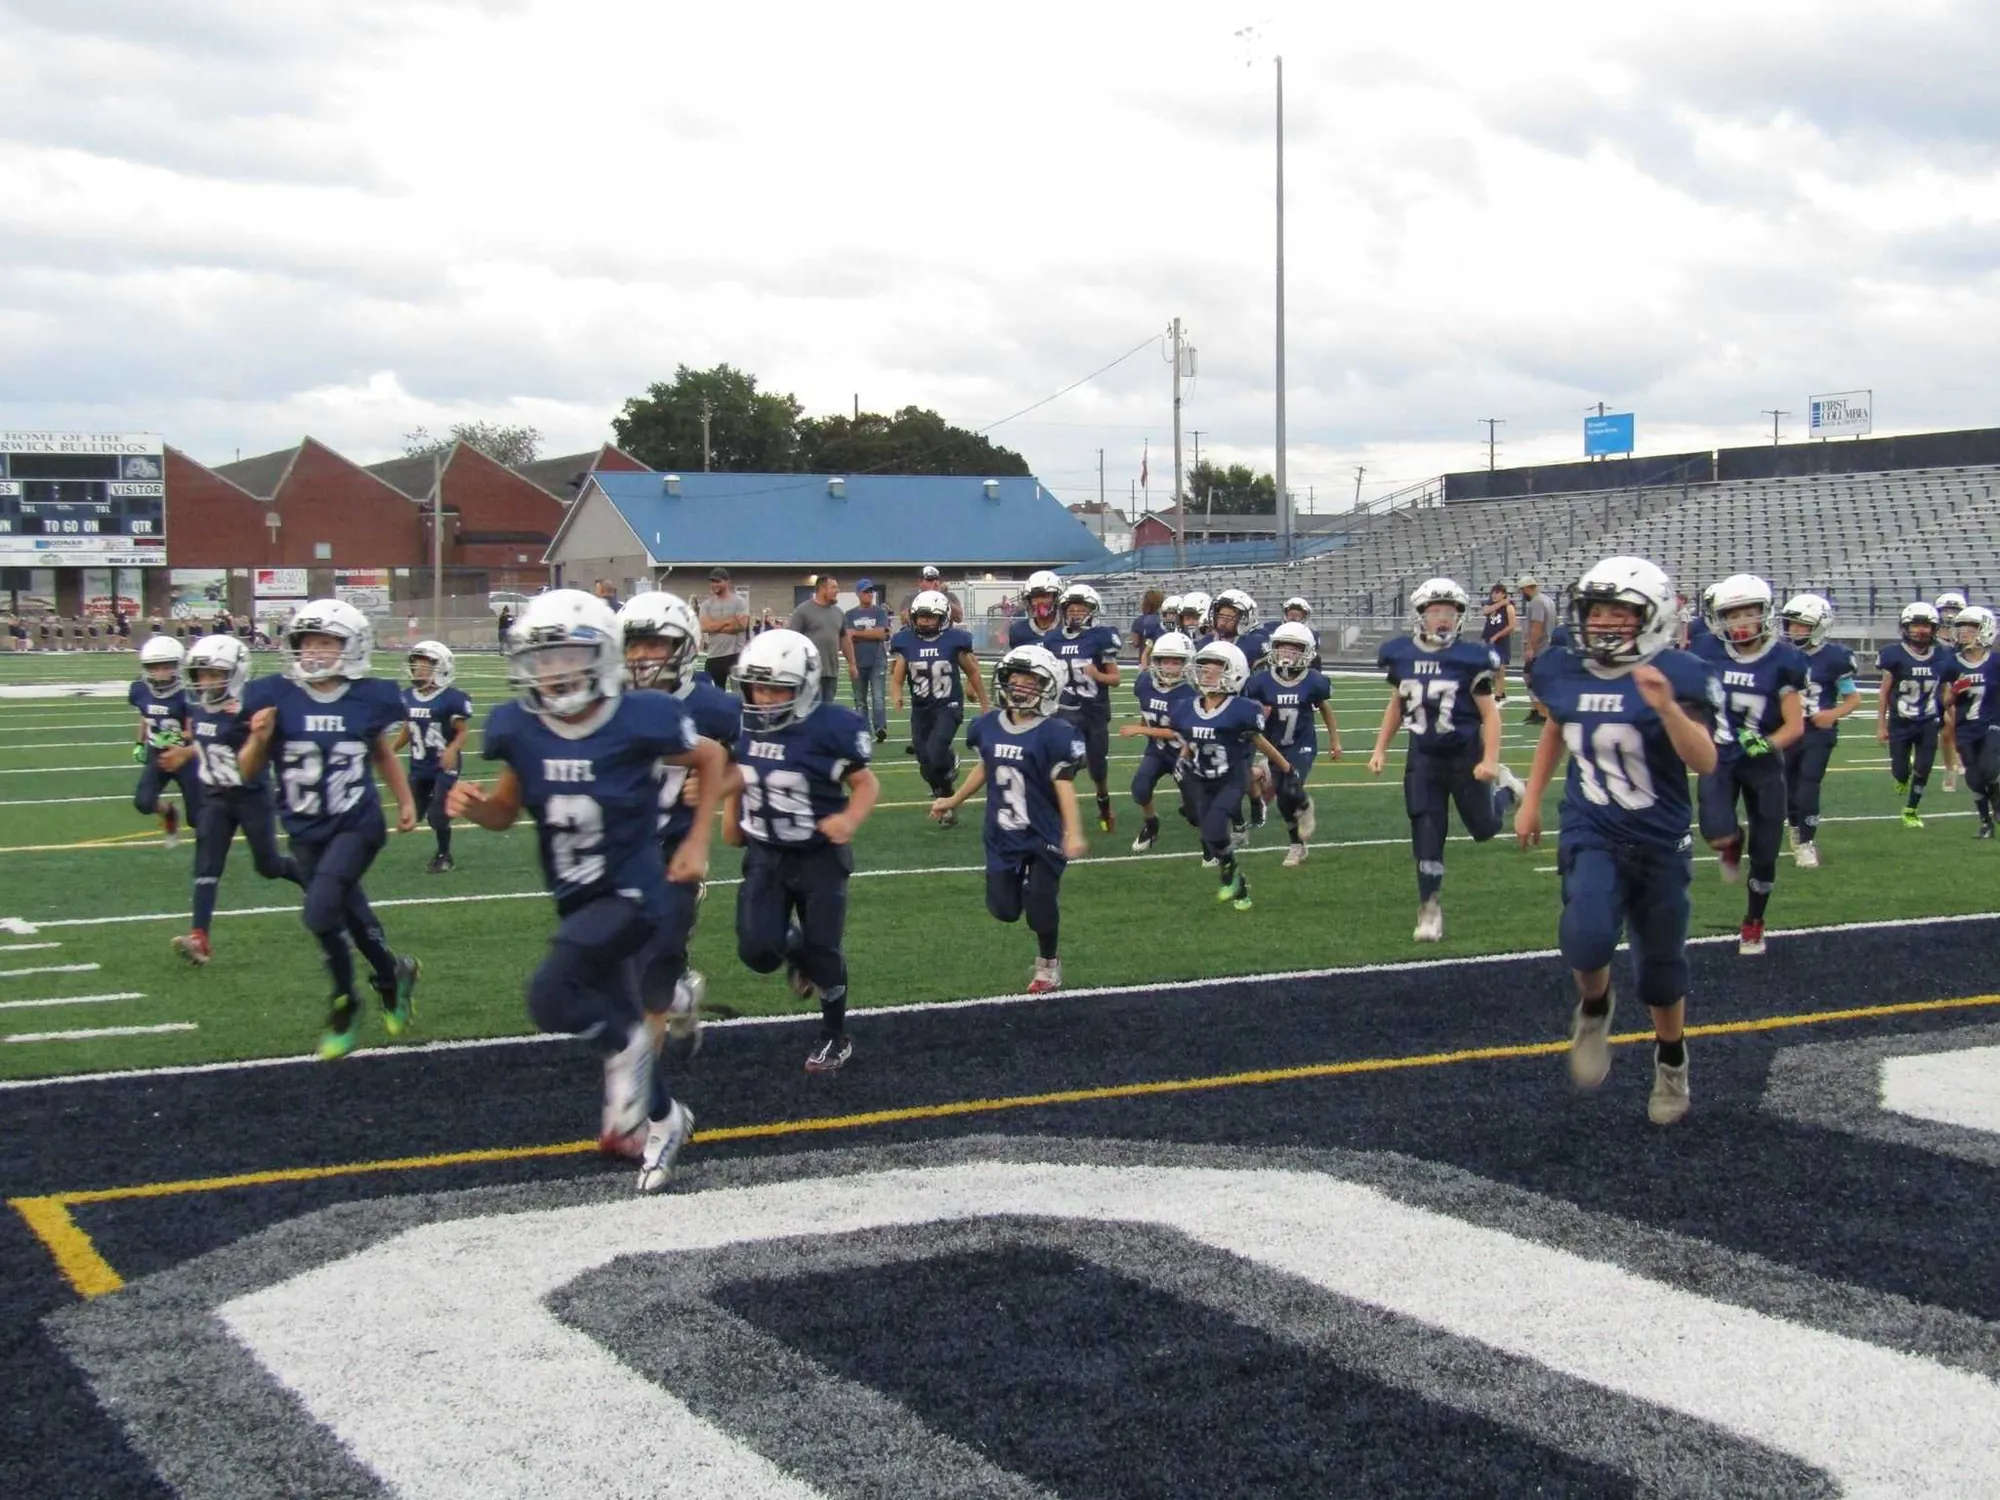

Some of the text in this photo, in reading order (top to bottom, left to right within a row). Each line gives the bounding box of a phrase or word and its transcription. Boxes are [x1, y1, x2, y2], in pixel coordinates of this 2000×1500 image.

[1822, 400, 1849, 411] FIRST
[1822, 408, 1868, 420] COLUMBIA
[5, 433, 55, 441] HOME
[60, 443, 148, 453] BULLDOGS
[112, 484, 161, 494] VISITOR
[44, 520, 79, 532] TO GO
[84, 520, 99, 532] ON
[132, 520, 152, 534] QTR
[920, 648, 939, 657] BYFL
[1414, 660, 1442, 675] BYFL
[1912, 667, 1932, 676] BYFL
[907, 660, 953, 699] 56
[1723, 670, 1755, 687] BYFL
[1149, 699, 1169, 711] BYFL
[1277, 694, 1299, 704] BYFL
[1576, 694, 1624, 712] BYFL
[1897, 679, 1940, 718] 27
[1399, 680, 1460, 735] 37
[304, 714, 346, 732] BYFL
[1278, 708, 1298, 746] 7
[407, 721, 452, 760] 34
[1193, 727, 1216, 739] BYFL
[748, 740, 785, 760] BYFL
[994, 743, 1024, 760] BYFL
[542, 758, 596, 782] BYFL
[1562, 722, 1659, 810] 10
[282, 741, 368, 815] 22
[995, 765, 1031, 830] 3
[545, 794, 606, 884] 2
